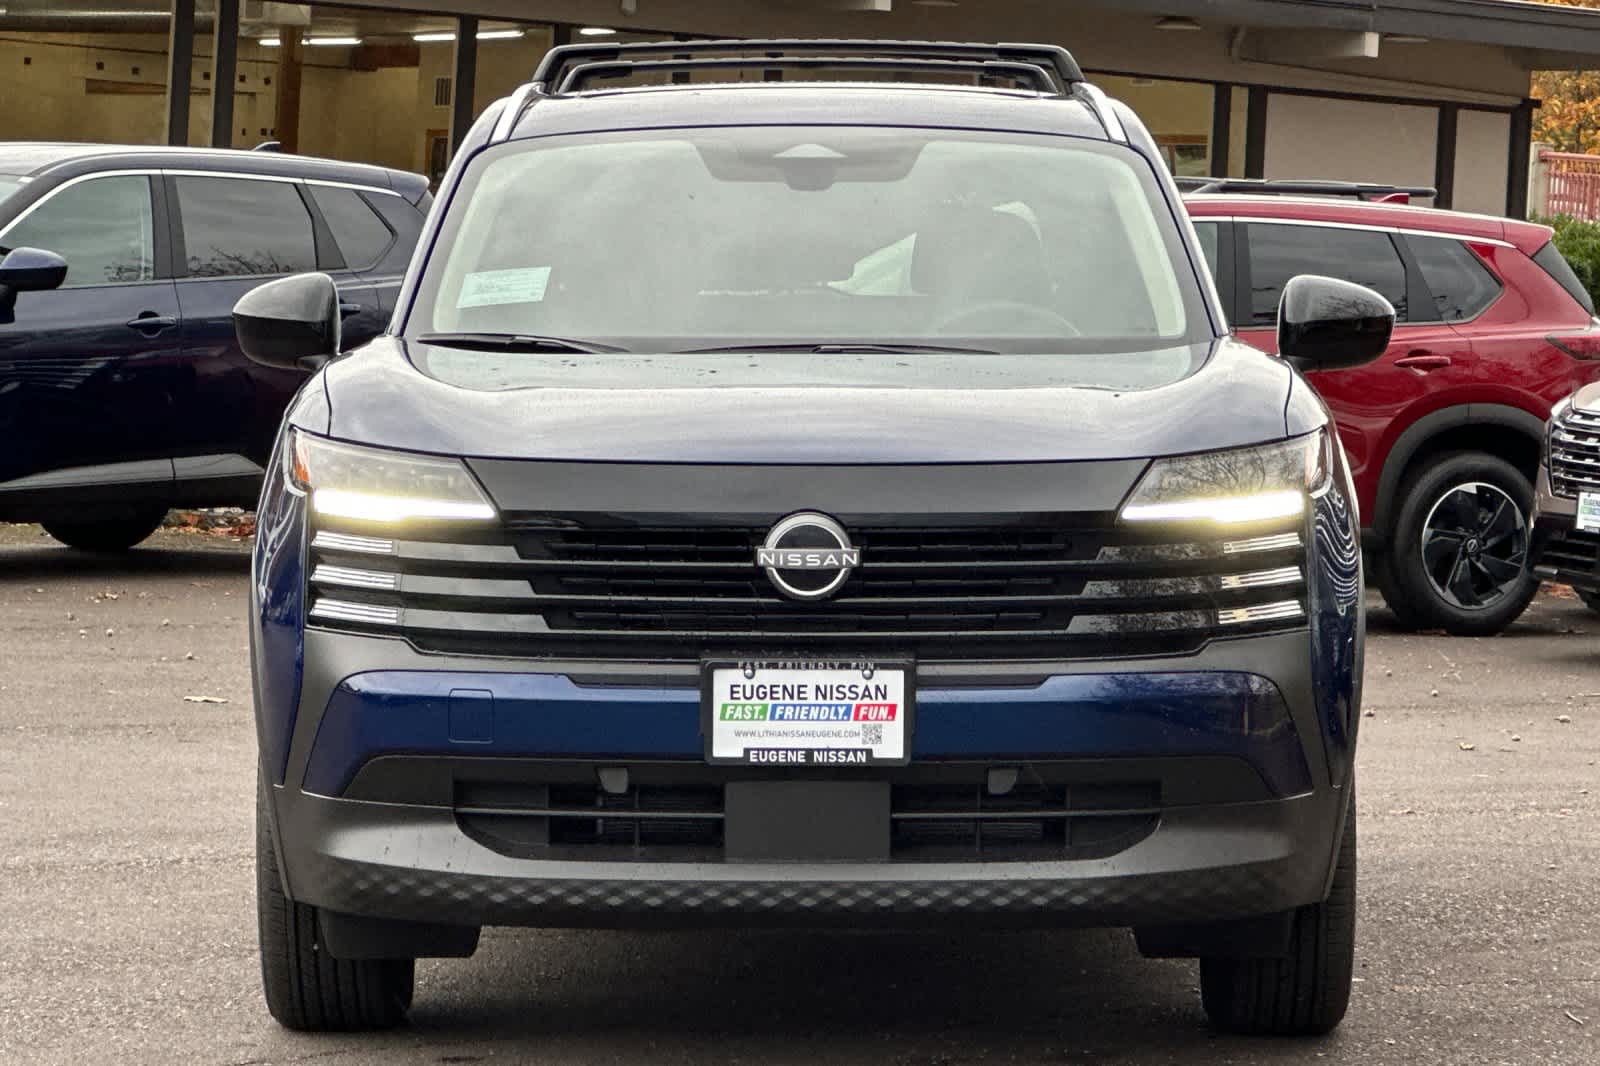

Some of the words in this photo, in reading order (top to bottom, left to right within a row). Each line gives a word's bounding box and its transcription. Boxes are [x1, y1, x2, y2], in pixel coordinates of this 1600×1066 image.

[760, 552, 857, 566] NISSAN
[730, 684, 808, 701] EUGENE
[815, 684, 888, 701] NISSAN
[725, 705, 764, 720] FAST.
[775, 705, 848, 720] FRIENDLY.
[858, 705, 893, 720] FUN.
[734, 729, 860, 738] WWW.LITHIANISSANEUGENE.COM
[749, 750, 806, 763] EUGENE
[813, 750, 867, 763] NISSAN
